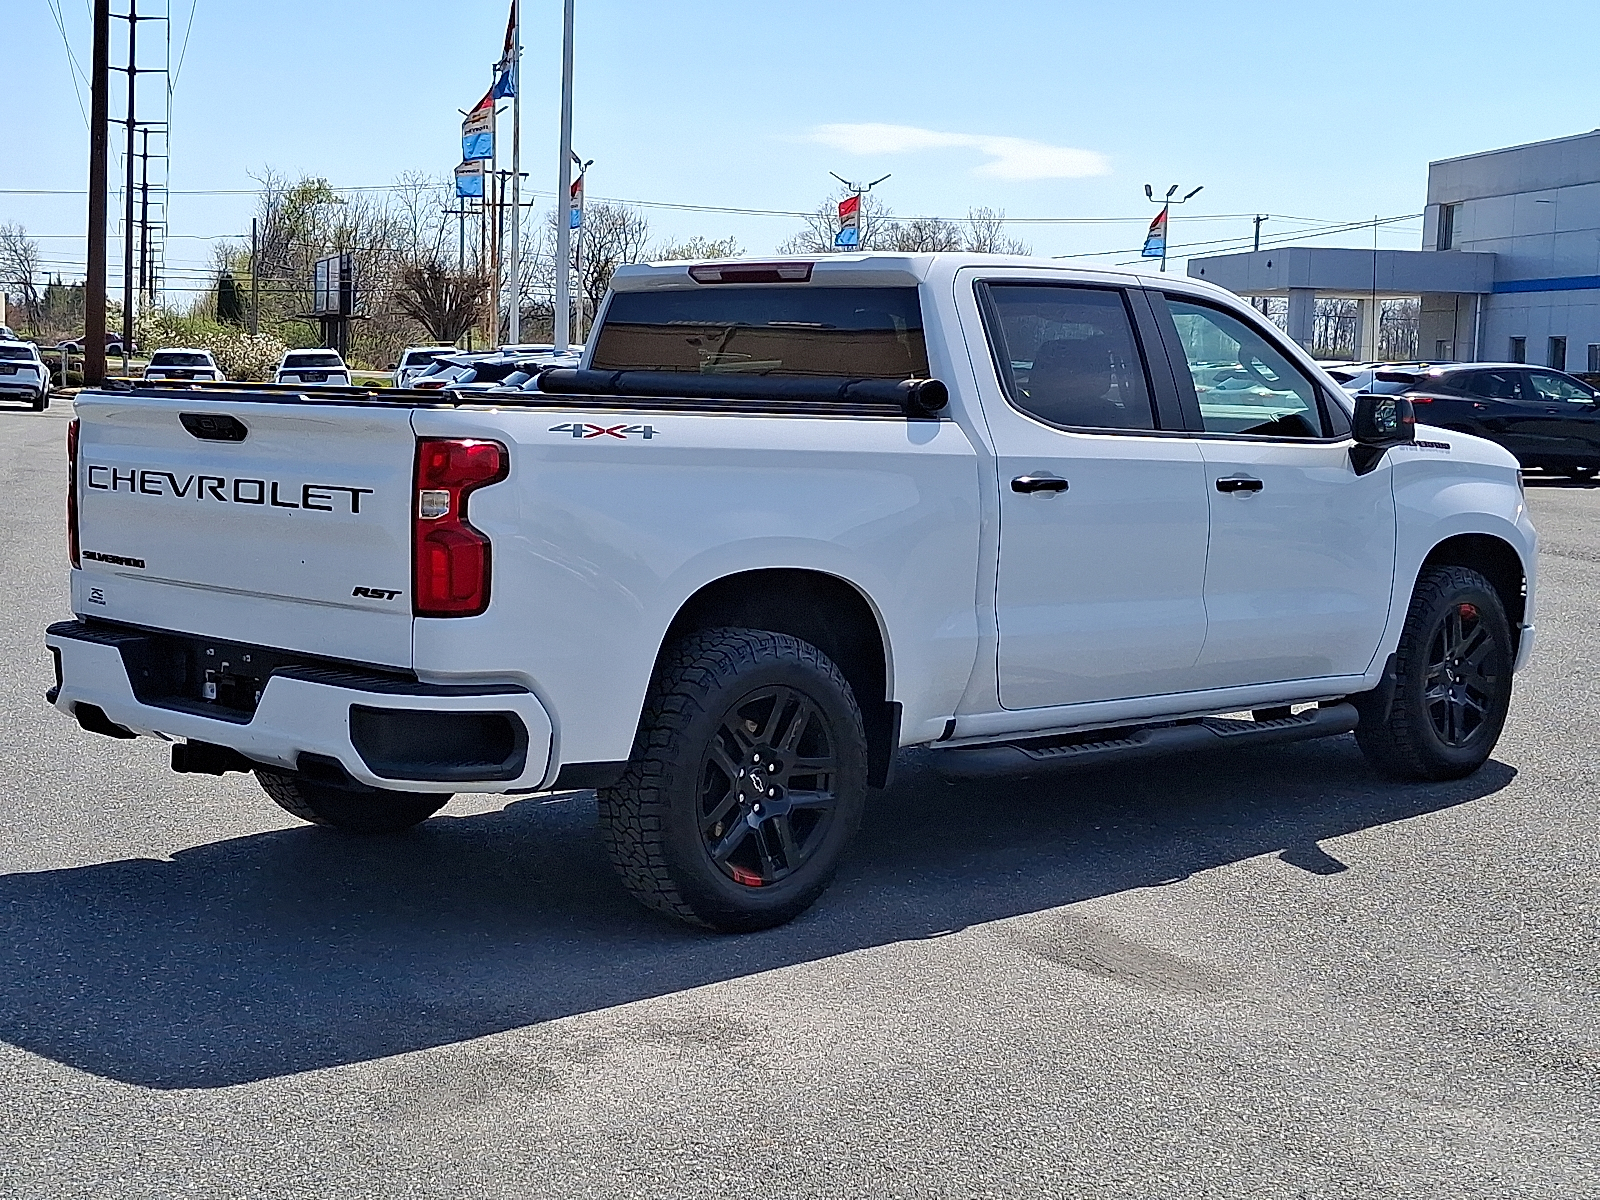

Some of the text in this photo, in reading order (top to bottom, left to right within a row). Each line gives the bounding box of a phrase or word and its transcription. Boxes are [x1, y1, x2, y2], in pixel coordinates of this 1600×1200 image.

[88, 465, 374, 513] CHEVROLET
[82, 550, 146, 569] SILVERADO
[352, 586, 402, 600] RST
